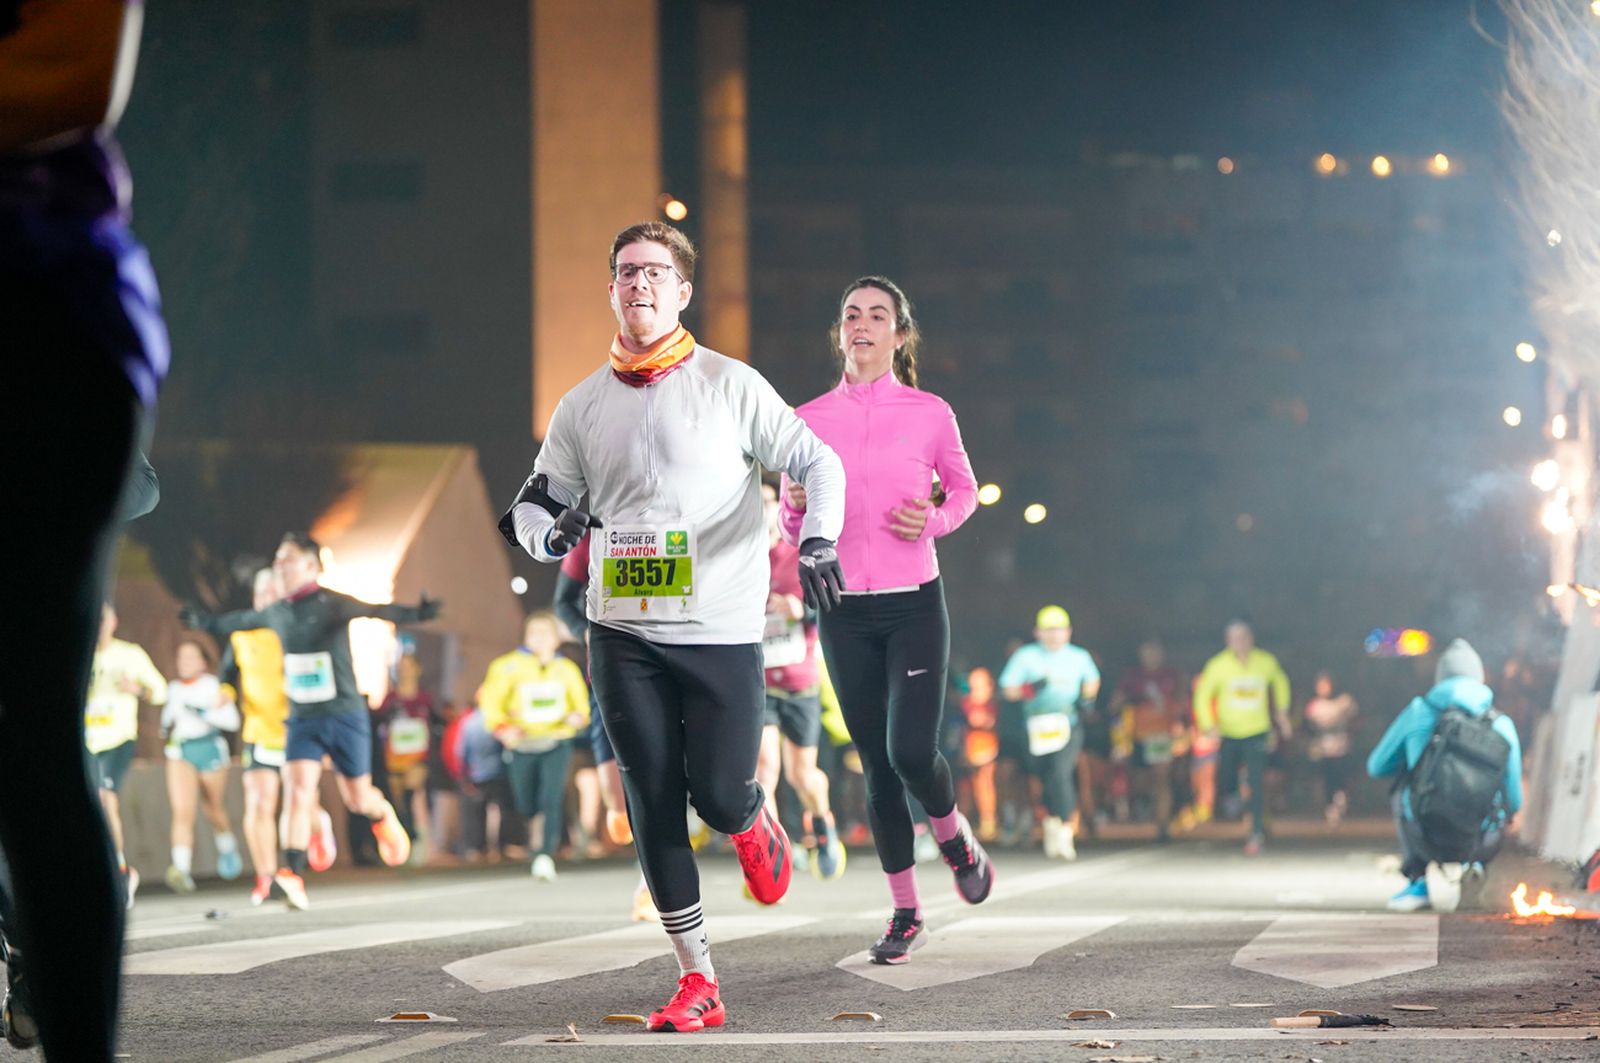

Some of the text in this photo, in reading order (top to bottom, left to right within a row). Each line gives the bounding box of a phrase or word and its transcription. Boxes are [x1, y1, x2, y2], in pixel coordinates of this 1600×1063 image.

[619, 535, 643, 544] NOCHE
[645, 535, 656, 544] DE
[611, 545, 656, 557] SAN ANTÓN
[616, 559, 676, 587] 3557
